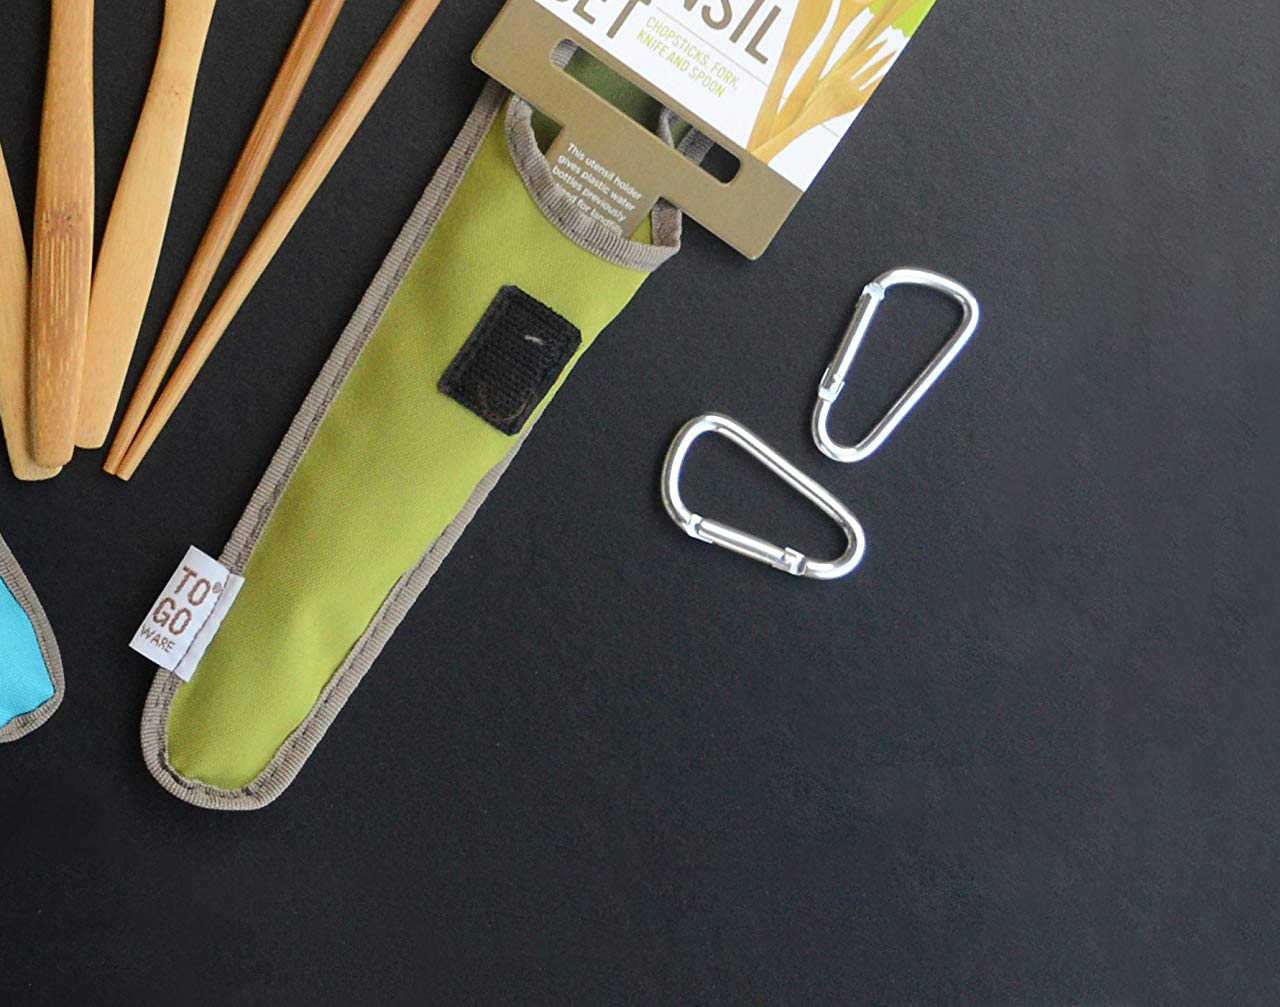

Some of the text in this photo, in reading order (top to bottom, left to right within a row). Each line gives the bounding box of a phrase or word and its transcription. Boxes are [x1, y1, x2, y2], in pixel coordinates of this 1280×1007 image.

[637, 29, 726, 97] KNIFE AND SPOON
[552, 165, 583, 191] bottles
[581, 188, 626, 223] previously
[557, 155, 637, 212] gives plastic water
[567, 142, 643, 200] This utensil holder
[174, 565, 211, 606] TO
[140, 625, 175, 653] WARE
[152, 597, 192, 635] GO
